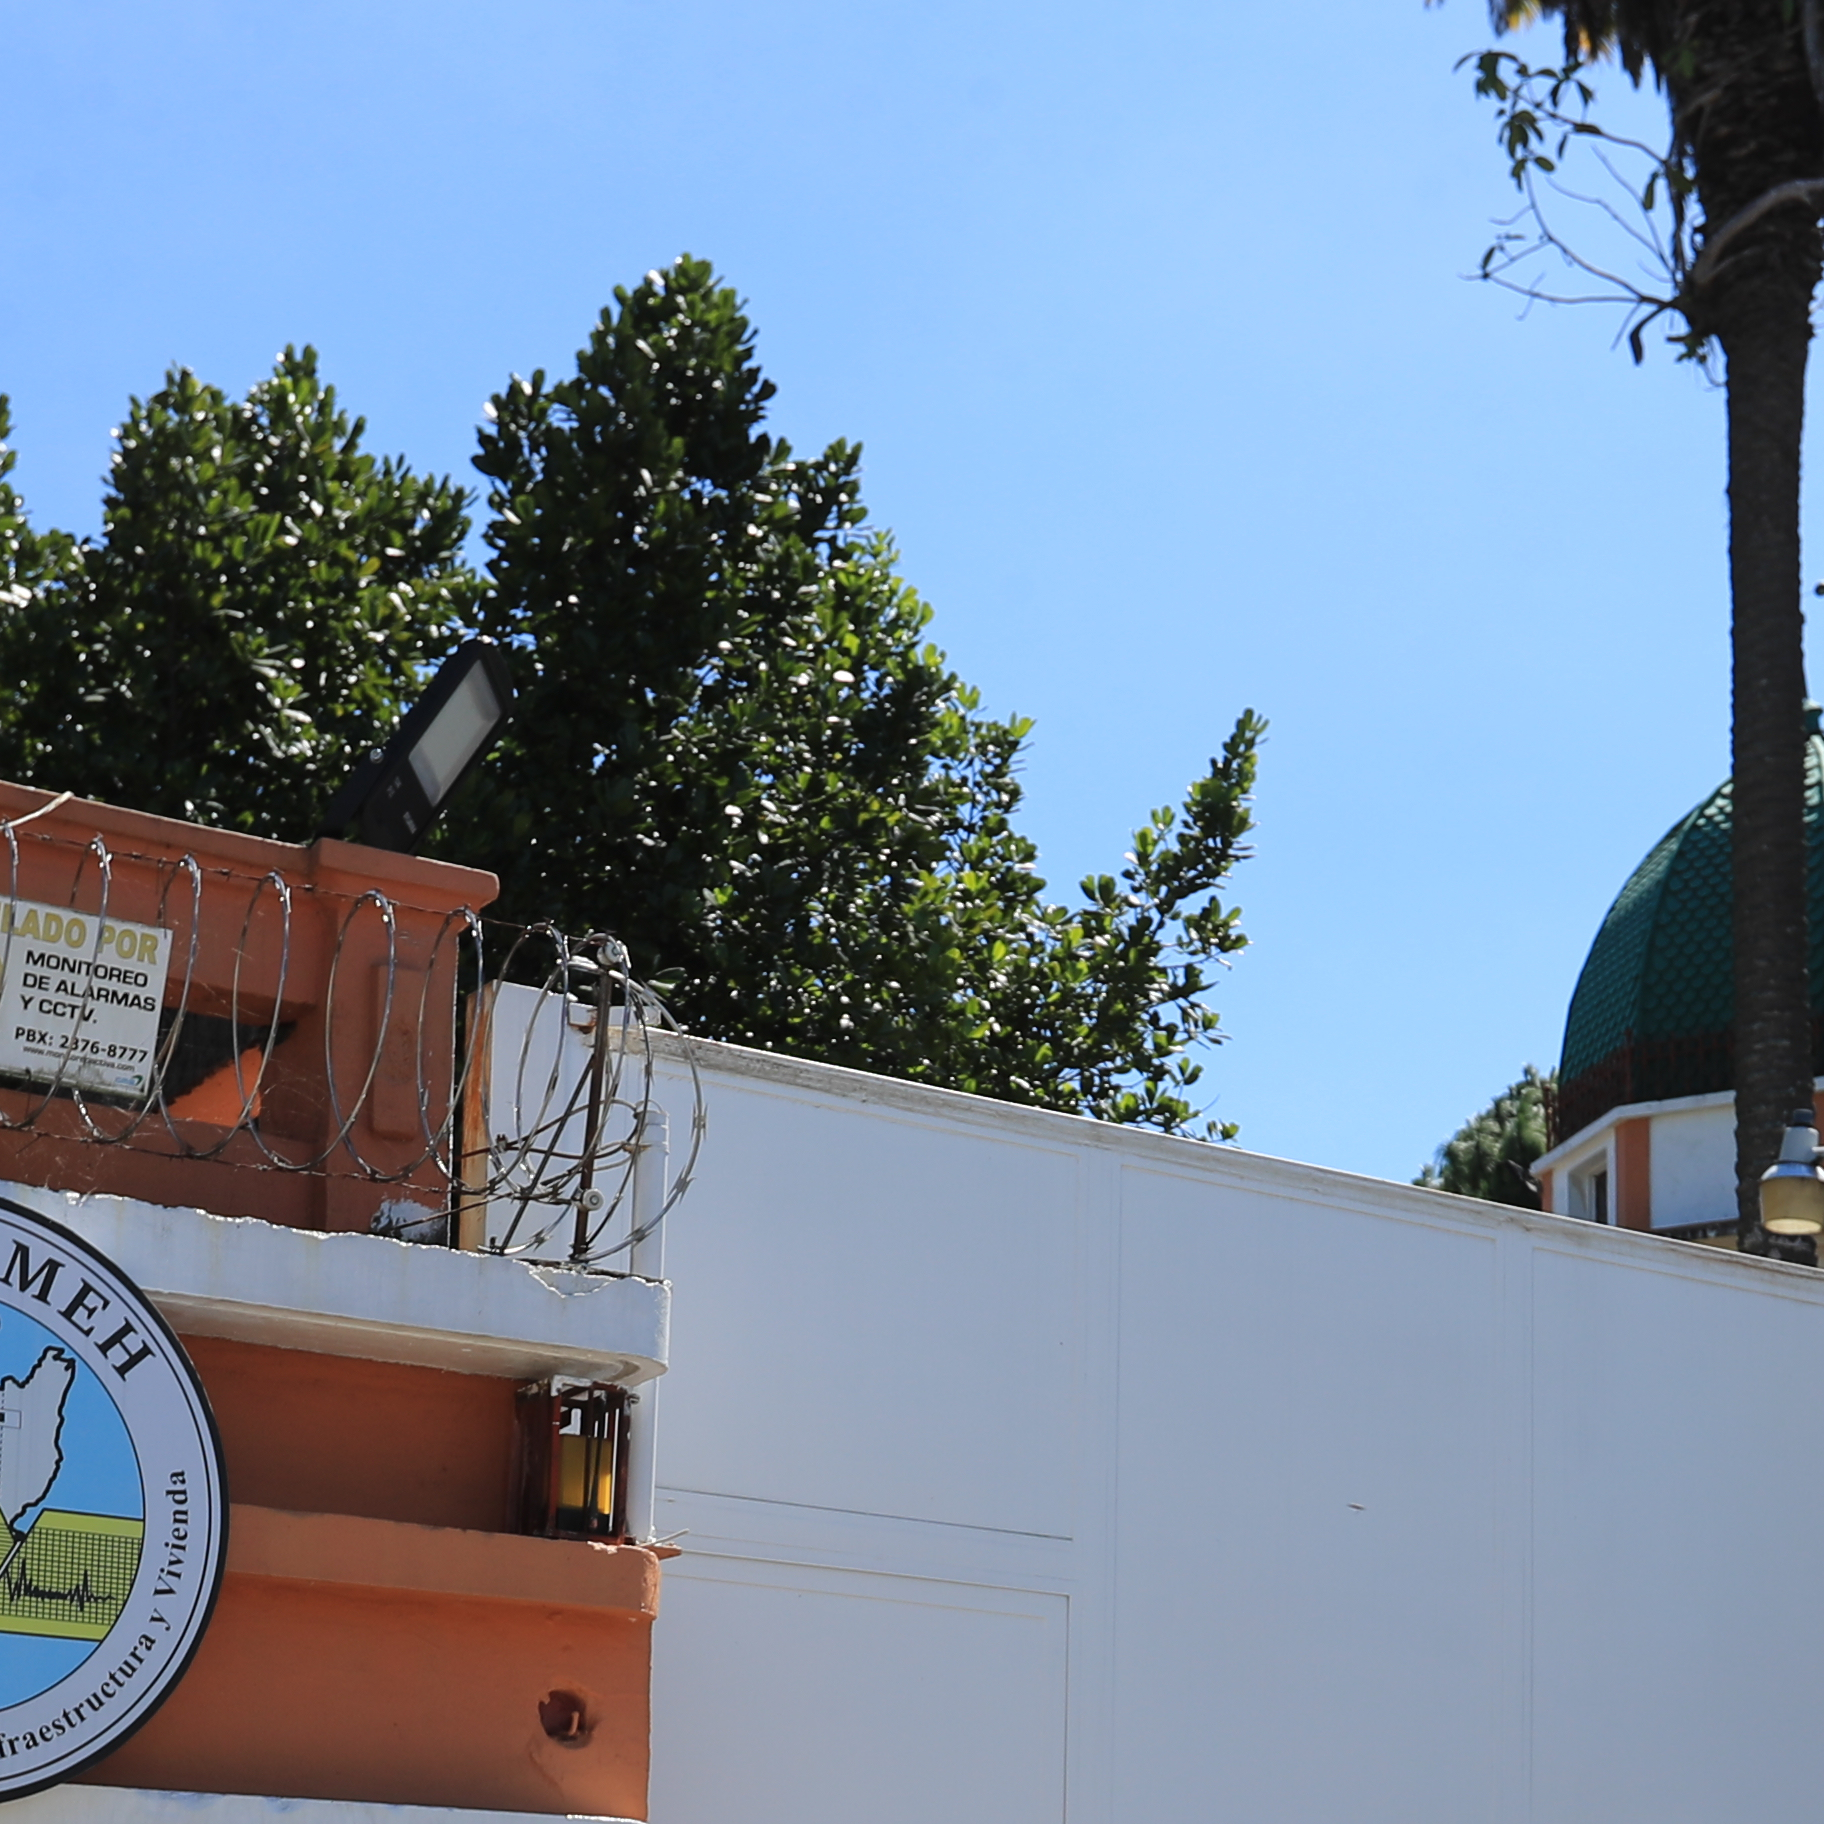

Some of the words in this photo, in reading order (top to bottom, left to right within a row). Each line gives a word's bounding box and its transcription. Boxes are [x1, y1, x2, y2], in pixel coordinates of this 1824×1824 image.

[96, 924, 159, 966] POR
[25, 949, 149, 988] MONITOREO
[20, 994, 35, 1011] Y
[22, 972, 51, 992] DE
[54, 979, 156, 1012] ALARMAS
[14, 1026, 53, 1047] PBX:
[152, 1469, 189, 1598] Vivienda
[149, 1607, 173, 1632] y
